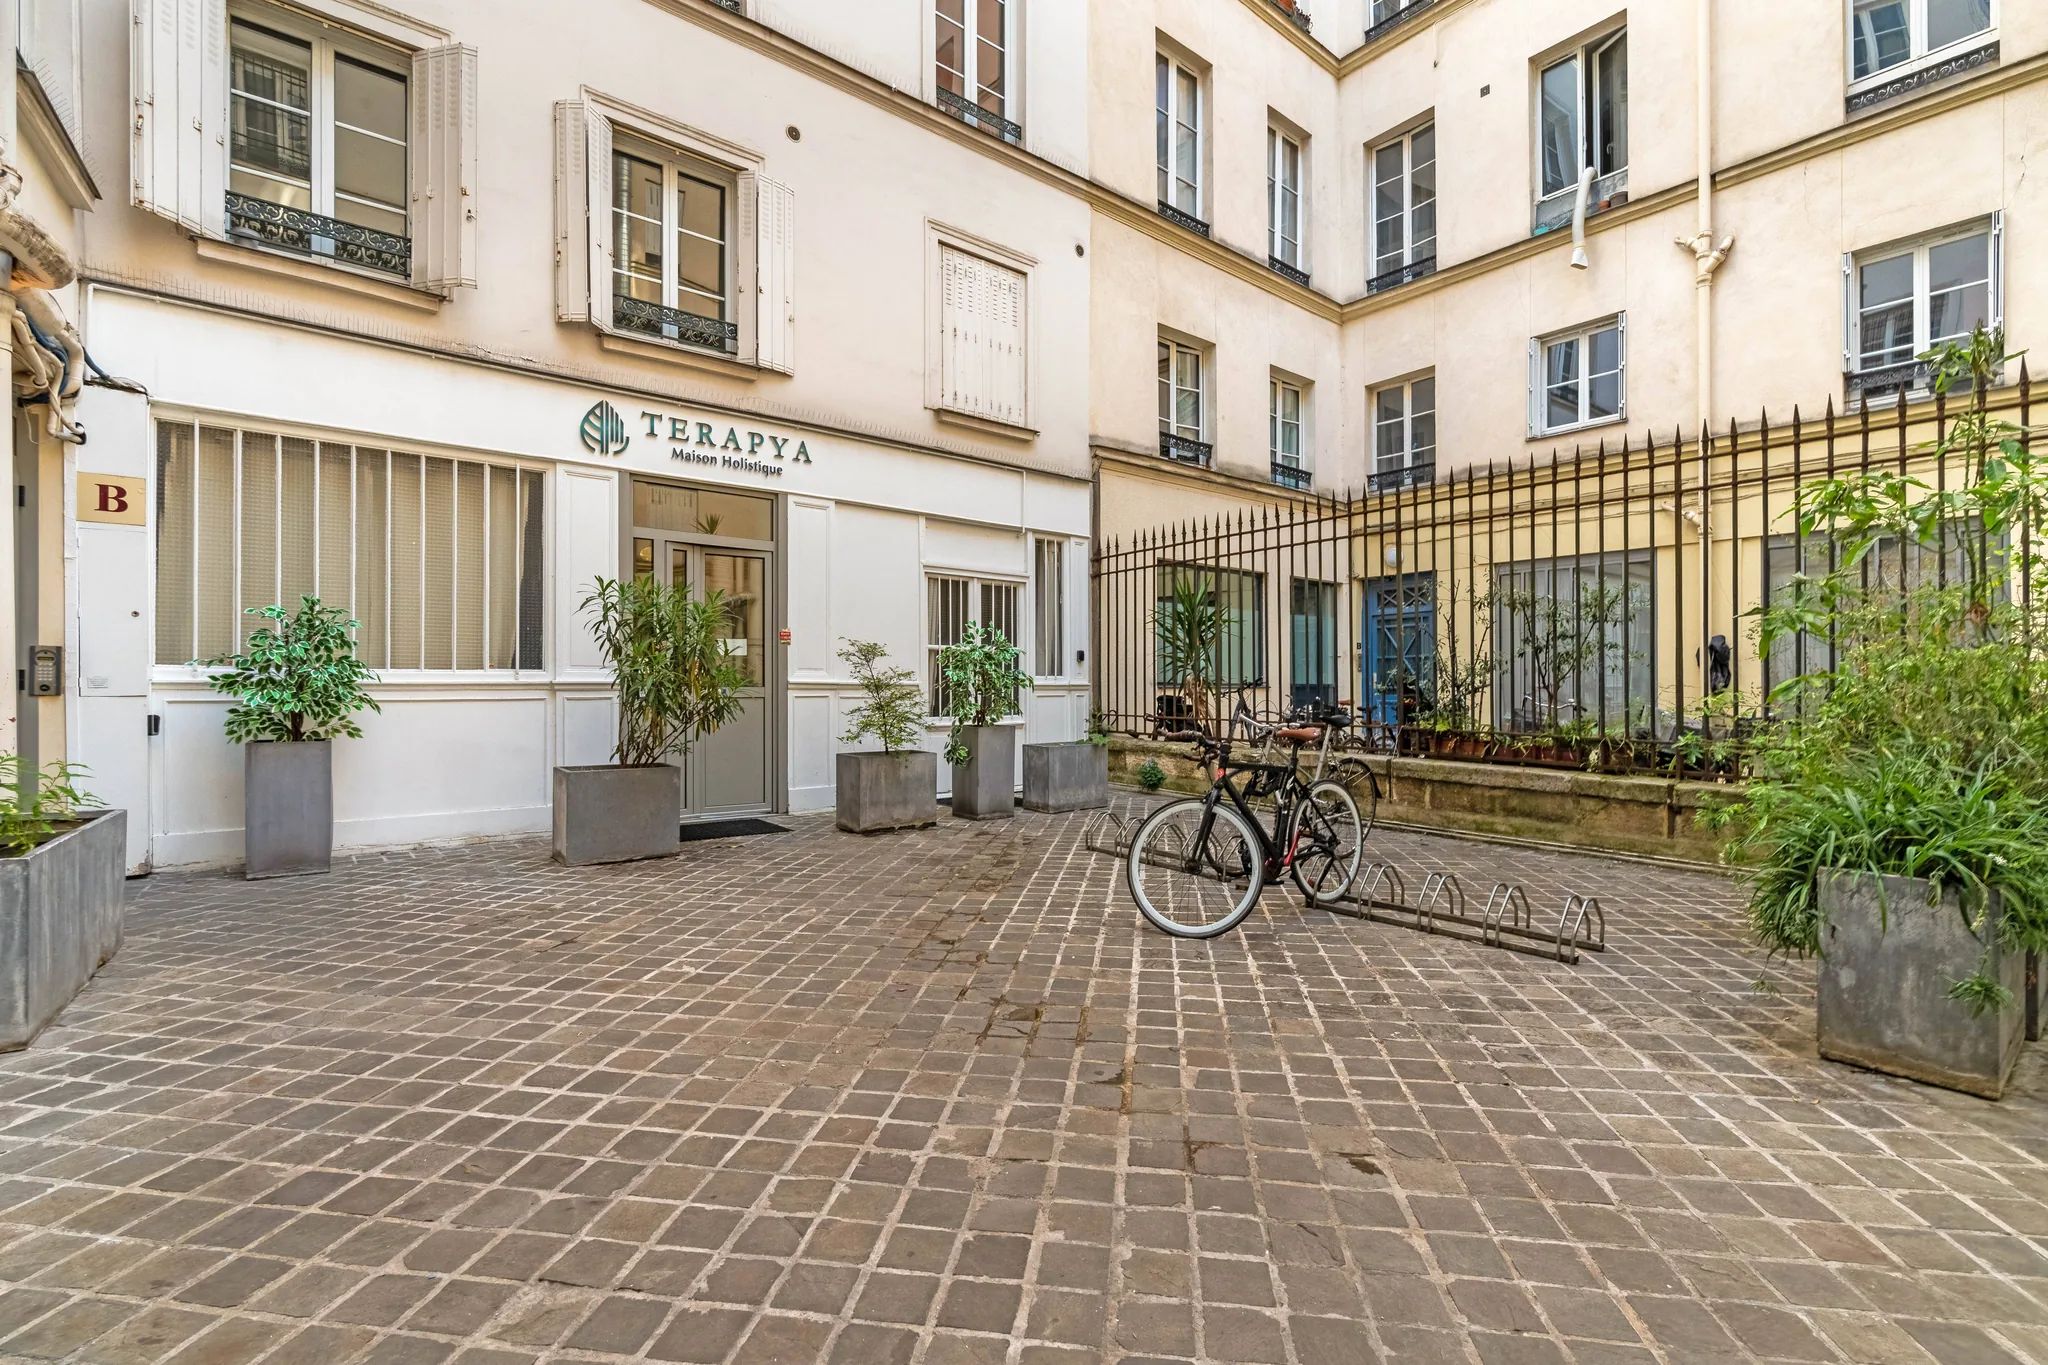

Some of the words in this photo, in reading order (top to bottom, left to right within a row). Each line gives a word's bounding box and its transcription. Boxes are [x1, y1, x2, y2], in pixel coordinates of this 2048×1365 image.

[641, 410, 813, 464] TERAPYA
[671, 447, 717, 465] Maison
[722, 455, 783, 477] Holistique
[94, 483, 128, 512] B
